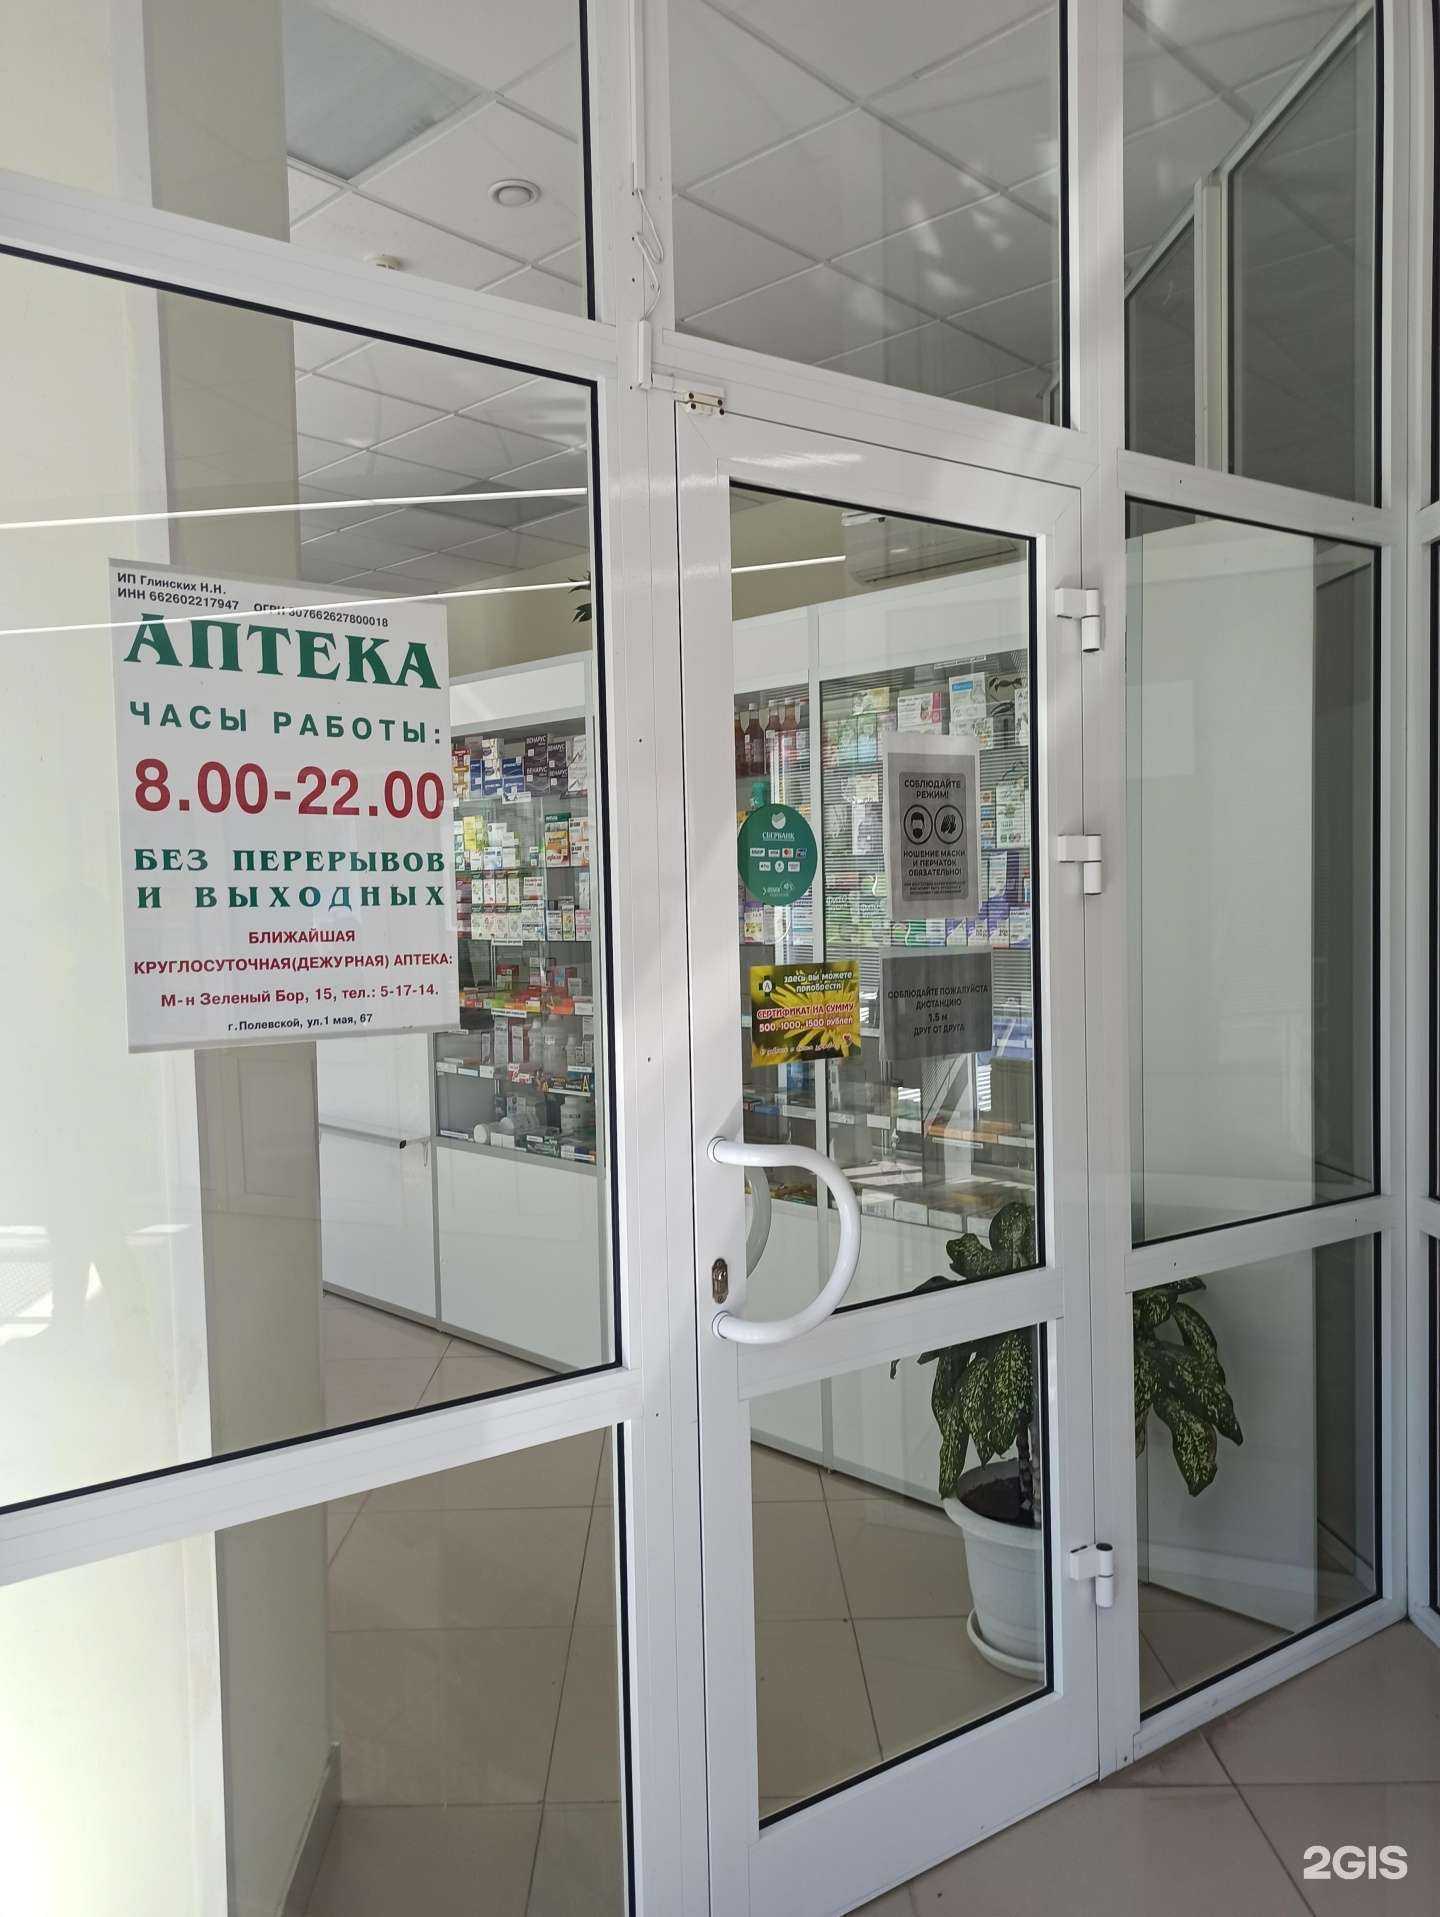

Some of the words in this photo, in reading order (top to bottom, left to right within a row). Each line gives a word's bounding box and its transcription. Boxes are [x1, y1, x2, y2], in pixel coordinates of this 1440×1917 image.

[117, 572, 136, 584] ИП
[140, 575, 197, 591] Глинских
[200, 582, 227, 595] Н.Н.
[117, 588, 146, 600] ИНН
[149, 591, 239, 610] 662602217947
[123, 612, 442, 690] АПТЕКА
[129, 701, 247, 732] ЧАСЫ
[273, 711, 441, 744] РАБОТЫ:
[134, 758, 445, 820] 8.00-22.00
[904, 779, 961, 789] СОБЛЮДАЙТЕ
[916, 790, 949, 799] РЕЖИМ!
[133, 848, 209, 872] БЕЗ
[232, 849, 446, 873] ПЕРЕРЫВОВ
[903, 850, 940, 858] НОШЕНИЕ
[940, 849, 966, 857] МАСКИ
[912, 859, 918, 867] И
[919, 859, 957, 867] ПЕРЧАТОК
[908, 868, 962, 877] ОБЯЗАТЕЛЬНО!
[136, 886, 162, 909] И
[194, 886, 445, 912] ВЫХОДНЫХ
[248, 929, 356, 945] БЛИЖАЙШАЯ
[133, 954, 390, 975] КРУГЛОСУТОЧНАЯ(ДЕЖУРНАЯ)
[393, 952, 454, 967] АПТЕКА:
[160, 993, 196, 1008] М-н
[199, 989, 271, 1006] Зеленый
[274, 989, 310, 1005] Бор,
[314, 987, 337, 1002] 15,
[341, 987, 376, 1000] тел.:
[379, 984, 439, 998] 5-17-14.
[887, 986, 938, 999] СОБЛЮДАЙТЕ
[940, 984, 989, 996] ПОЖАЛУЙСТА
[757, 1006, 811, 1019] СЕРТИФИКАТ
[812, 1004, 824, 1014] НА
[825, 1003, 854, 1013] СУММУ
[915, 998, 962, 1010] ДИСТАНЦИЮ
[227, 1017, 303, 1032] г.Полевской,
[359, 1013, 374, 1024] 67
[805, 1019, 824, 1028] 1500
[913, 1026, 932, 1037] ДРУГ
[943, 1023, 966, 1034] ДРУГА
